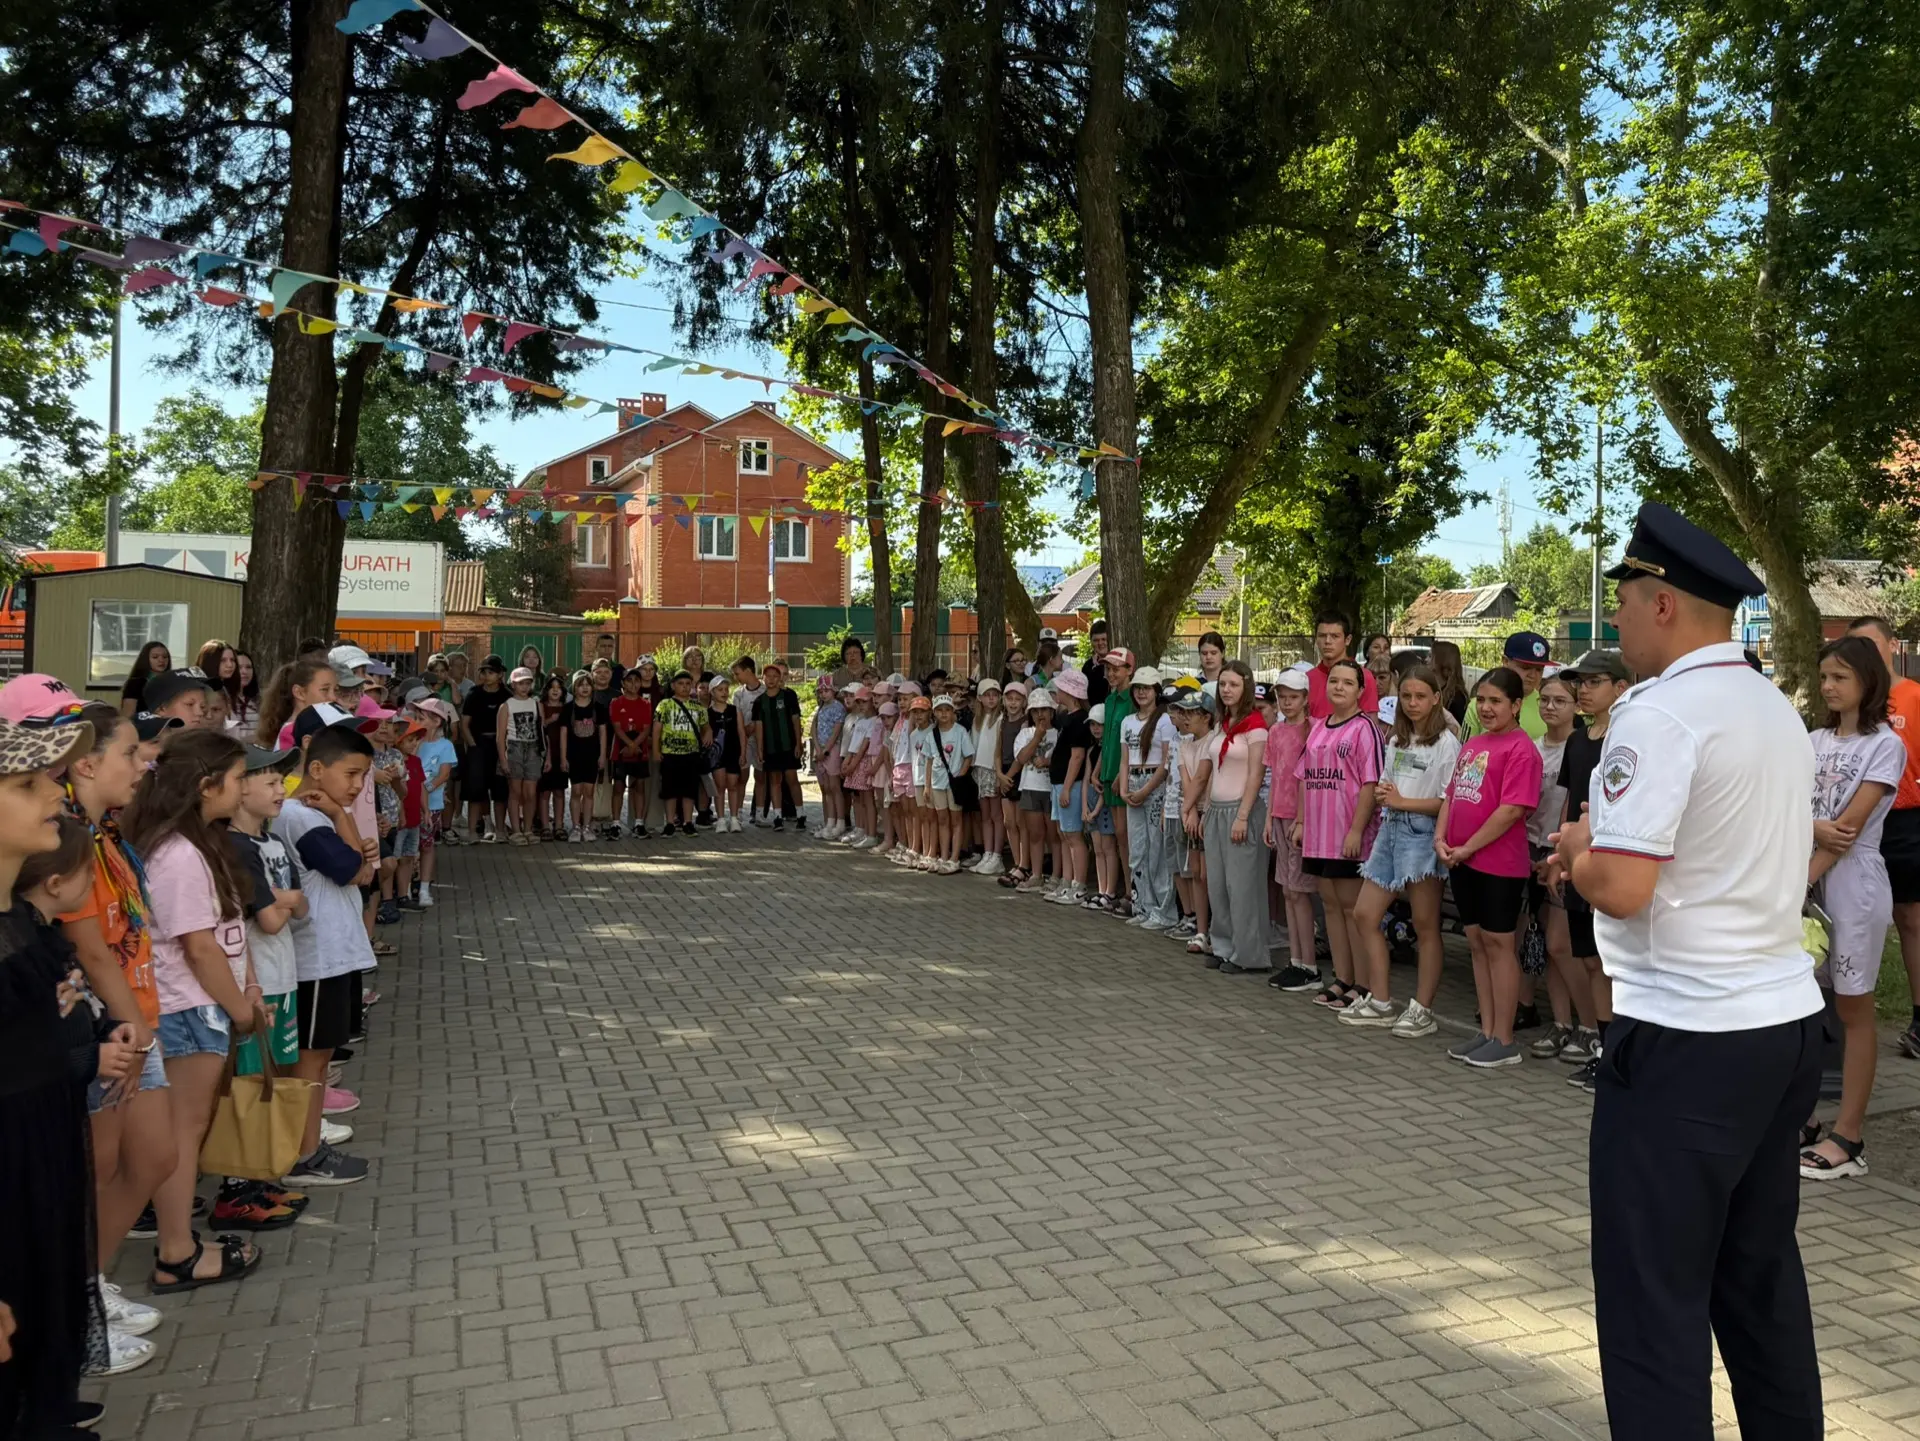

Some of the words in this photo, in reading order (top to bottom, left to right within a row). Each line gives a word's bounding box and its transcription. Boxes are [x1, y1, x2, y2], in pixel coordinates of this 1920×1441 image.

[343, 555, 411, 573] URATH
[339, 576, 410, 593] Systeme
[1306, 781, 1338, 790] ORIGINAL
